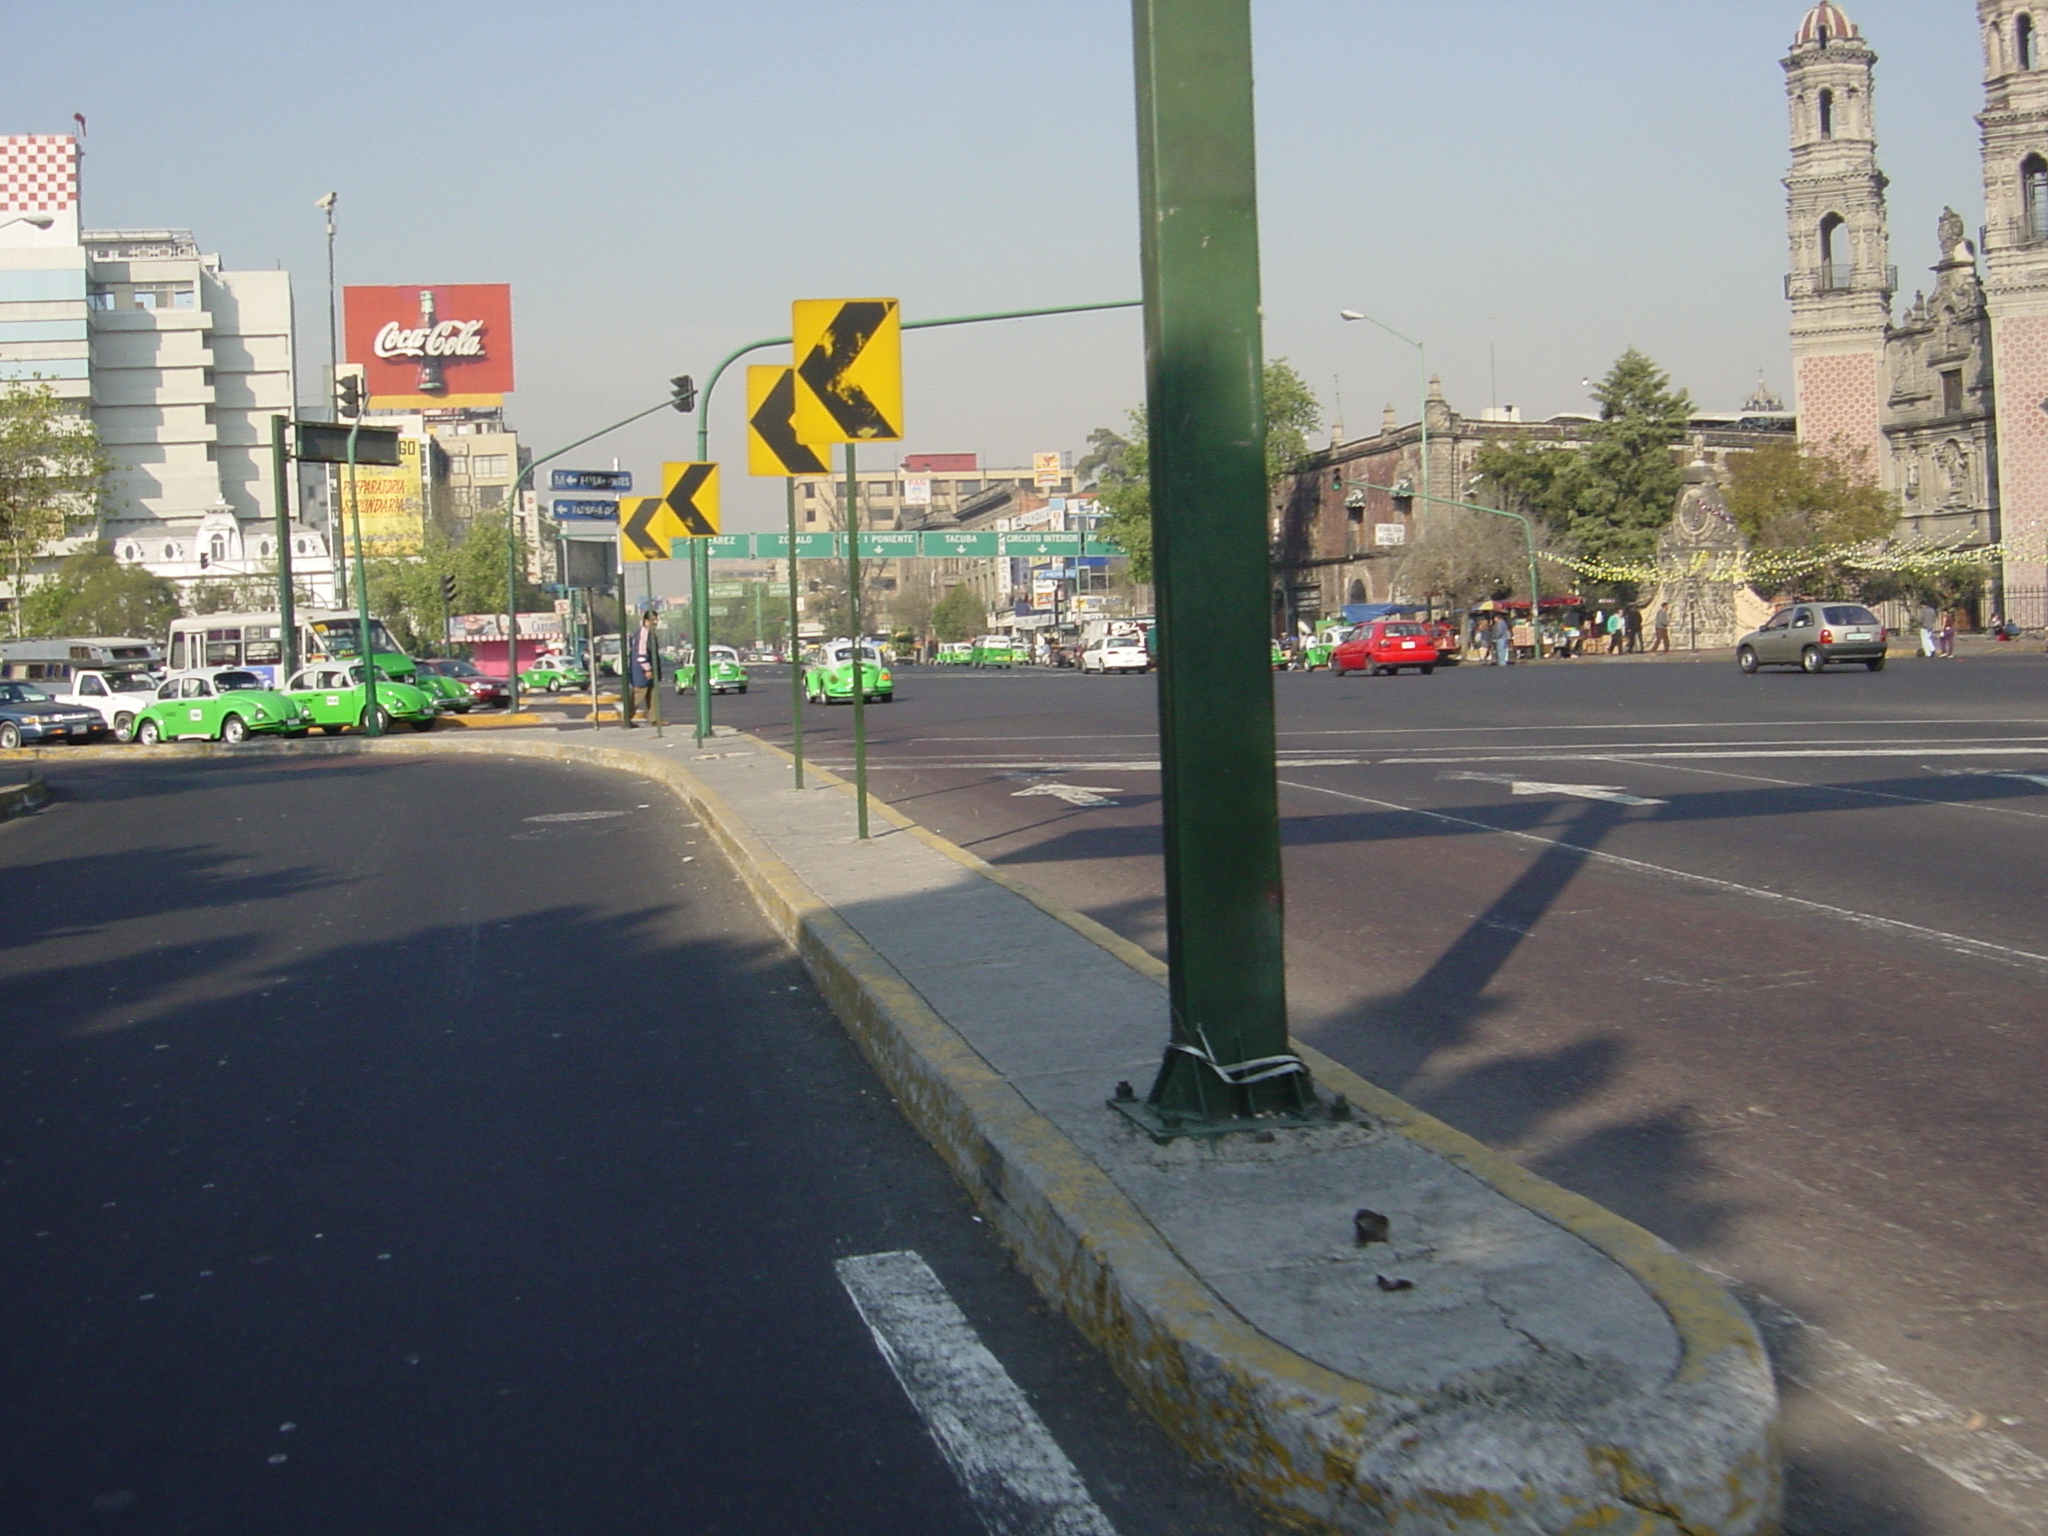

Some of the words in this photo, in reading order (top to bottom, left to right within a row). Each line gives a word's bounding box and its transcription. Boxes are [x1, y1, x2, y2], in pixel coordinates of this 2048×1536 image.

[374, 319, 486, 358] Coca-Cola
[343, 479, 406, 495] PEPARATORIA
[342, 497, 406, 514] SCUNDARIA
[778, 535, 812, 545] ZOALO
[871, 535, 914, 544] PONIENTE
[945, 534, 977, 543] TACUBA
[1006, 534, 1042, 543] CIRCUITO
[1043, 534, 1078, 543] INTERIOR
